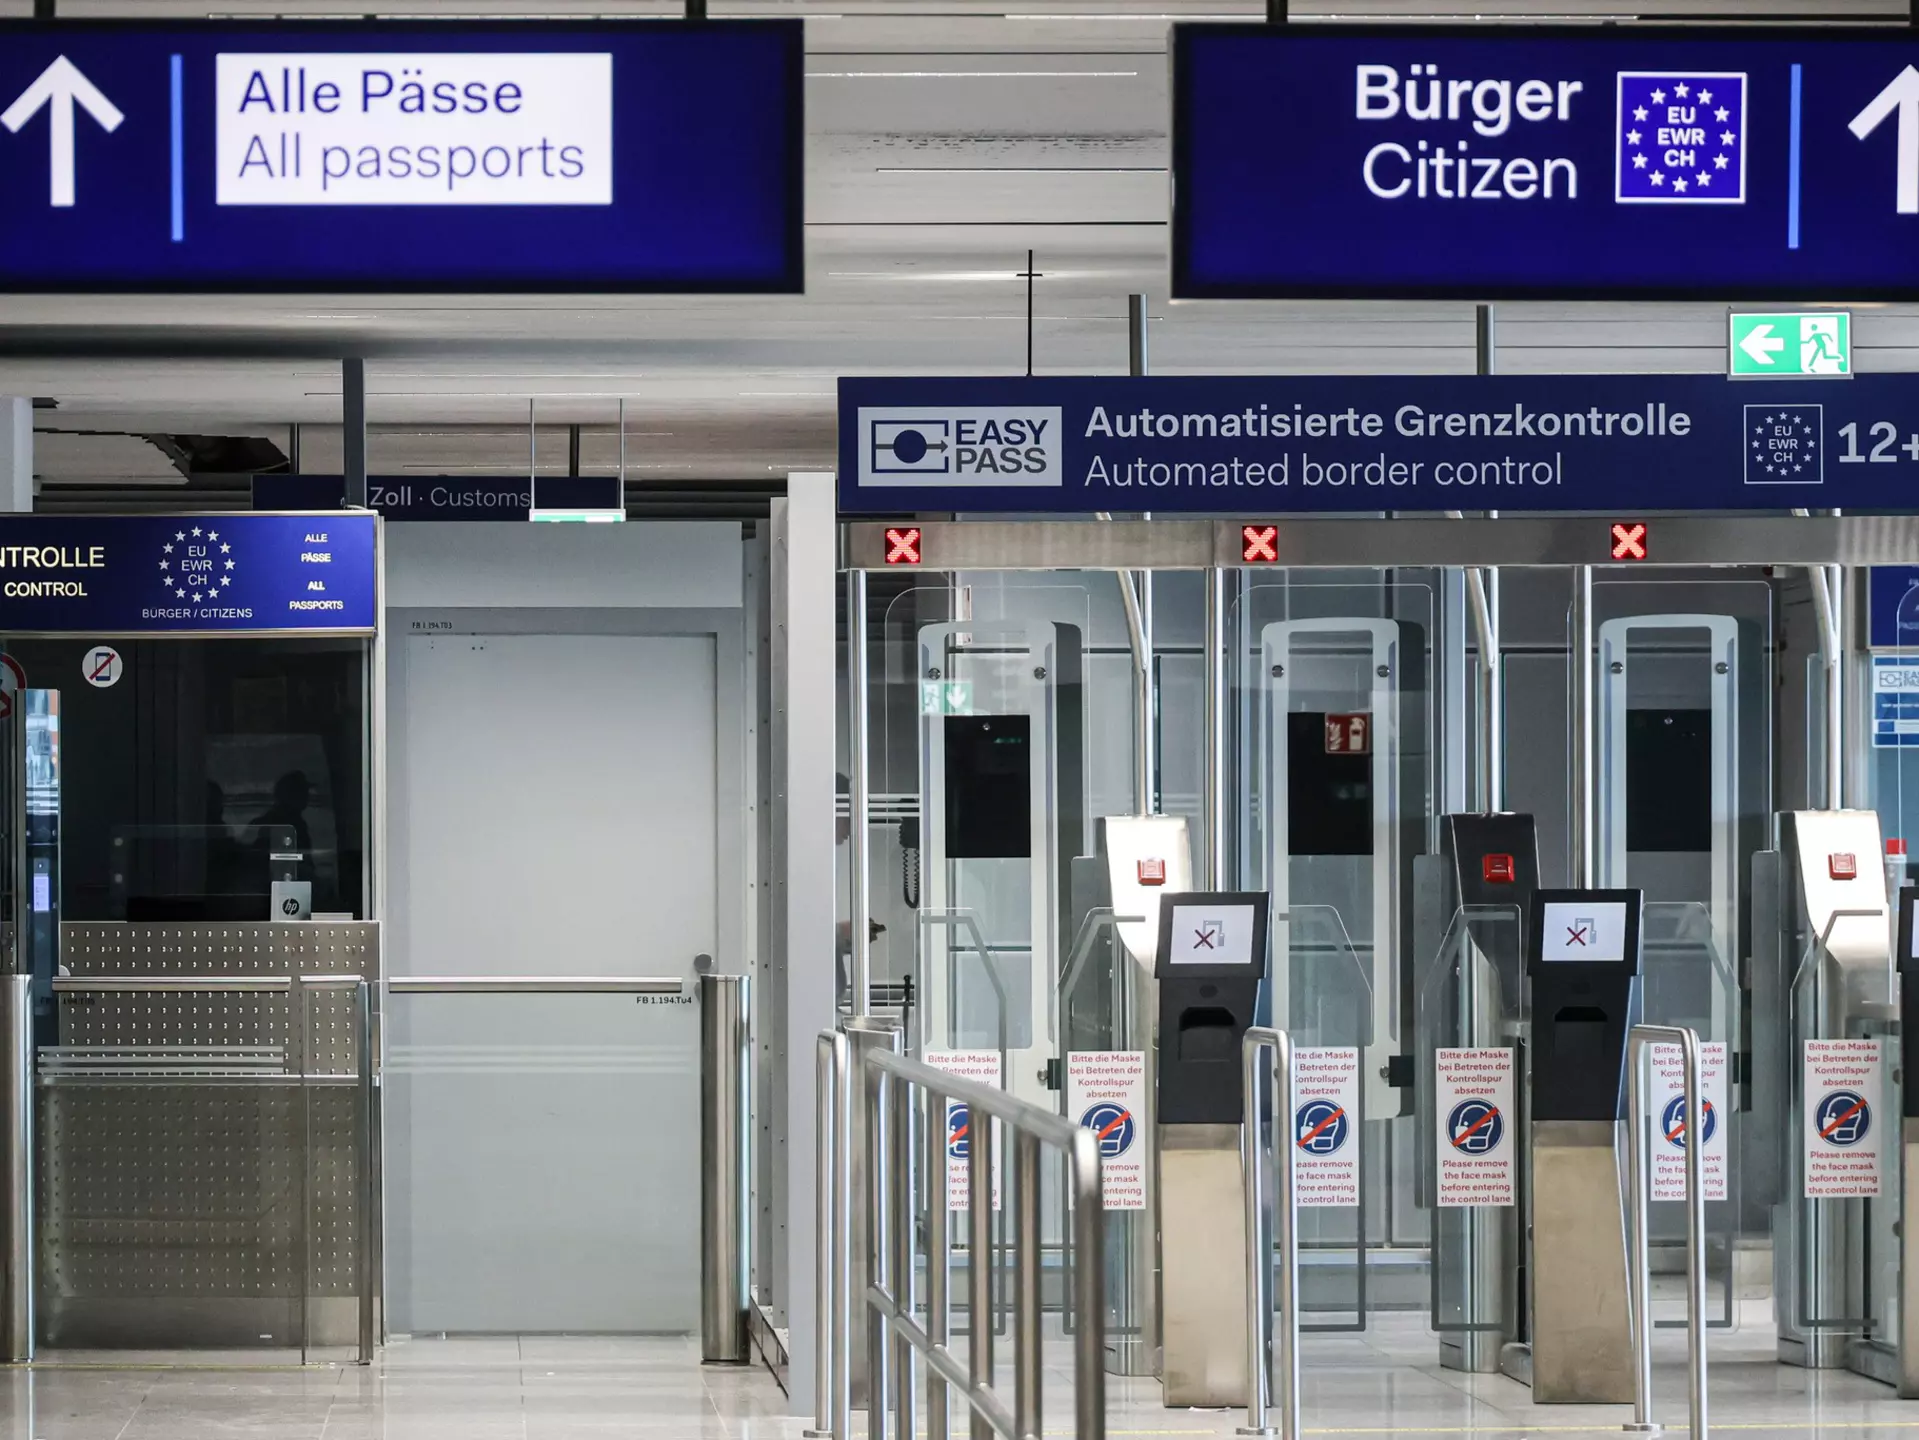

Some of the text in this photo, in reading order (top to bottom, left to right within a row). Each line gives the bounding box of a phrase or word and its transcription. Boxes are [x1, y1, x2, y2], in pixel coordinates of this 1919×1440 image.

[238, 68, 523, 115] Alle Pässe
[1356, 63, 1582, 136] Bürger
[1667, 107, 1695, 125] EU
[1657, 128, 1705, 146] EWR
[238, 132, 585, 191] All passports
[1664, 150, 1695, 168] CH
[1362, 141, 1577, 199] Citizen
[1085, 403, 1691, 438] Automatisierte Grenzkontrolle
[955, 419, 1049, 446] EASY
[1774, 425, 1792, 437] EU
[1768, 438, 1799, 450] EWR
[1838, 421, 1919, 463] 12+
[955, 447, 1047, 474] PASS
[1774, 451, 1793, 463] CH
[1085, 453, 1562, 487] Automated border control
[370, 486, 412, 506] Zoll
[431, 486, 531, 508] Customs
[305, 533, 328, 543] ALLE
[188, 546, 206, 556] EU
[181, 560, 213, 571] EWR
[188, 574, 207, 585] CH
[4, 581, 88, 597] CONTROL
[308, 581, 325, 591] ALL
[289, 600, 343, 611] PASSPORTS
[200, 608, 253, 618] CITIZENS
[283, 898, 299, 915] hp
[1654, 1045, 1676, 1053] Bitte
[1702, 1045, 1723, 1053] aske
[1808, 1043, 1877, 1051] Bitte die Maske
[928, 1055, 997, 1063] Bitte die Maske
[1072, 1055, 1140, 1063] Bitte die Maske
[1325, 1051, 1354, 1059] Maske
[1440, 1051, 1509, 1059] Bitte die Maske
[1807, 1055, 1878, 1063] bei Betreten der
[1652, 1057, 1667, 1065] bei
[1709, 1057, 1724, 1065] der
[983, 1066, 998, 1075] der
[1070, 1066, 1142, 1075] bei Betreten der
[1341, 1063, 1356, 1071] der
[1438, 1063, 1510, 1071] bei Betreten der
[1814, 1067, 1870, 1075] Kontrollspur
[1078, 1078, 1134, 1087] Kontrollspur
[1446, 1074, 1502, 1083] Kontrollspur
[1822, 1078, 1864, 1086] absetzen
[1086, 1090, 1127, 1098] absetzen
[1300, 1087, 1341, 1095] absetzen
[1454, 1086, 1496, 1094] absetzen
[1810, 1150, 1841, 1159] Please
[1442, 1159, 1472, 1168] Please
[1829, 1162, 1848, 1170] face
[1849, 1162, 1874, 1170] mask
[1114, 1175, 1139, 1183] mask
[1306, 1172, 1326, 1180] face
[1327, 1172, 1352, 1180] mask
[1444, 1171, 1507, 1179] the face mask
[1809, 1174, 1878, 1184] before entering
[1104, 1187, 1142, 1196] entering
[1317, 1183, 1355, 1193] entering
[1441, 1182, 1510, 1193] before entering
[1809, 1185, 1878, 1194] the control lane
[1654, 1189, 1669, 1197] the
[1704, 1189, 1724, 1197] lane
[1302, 1196, 1335, 1204] control
[1337, 1195, 1356, 1203] lane
[1441, 1194, 1511, 1203] the control lane
